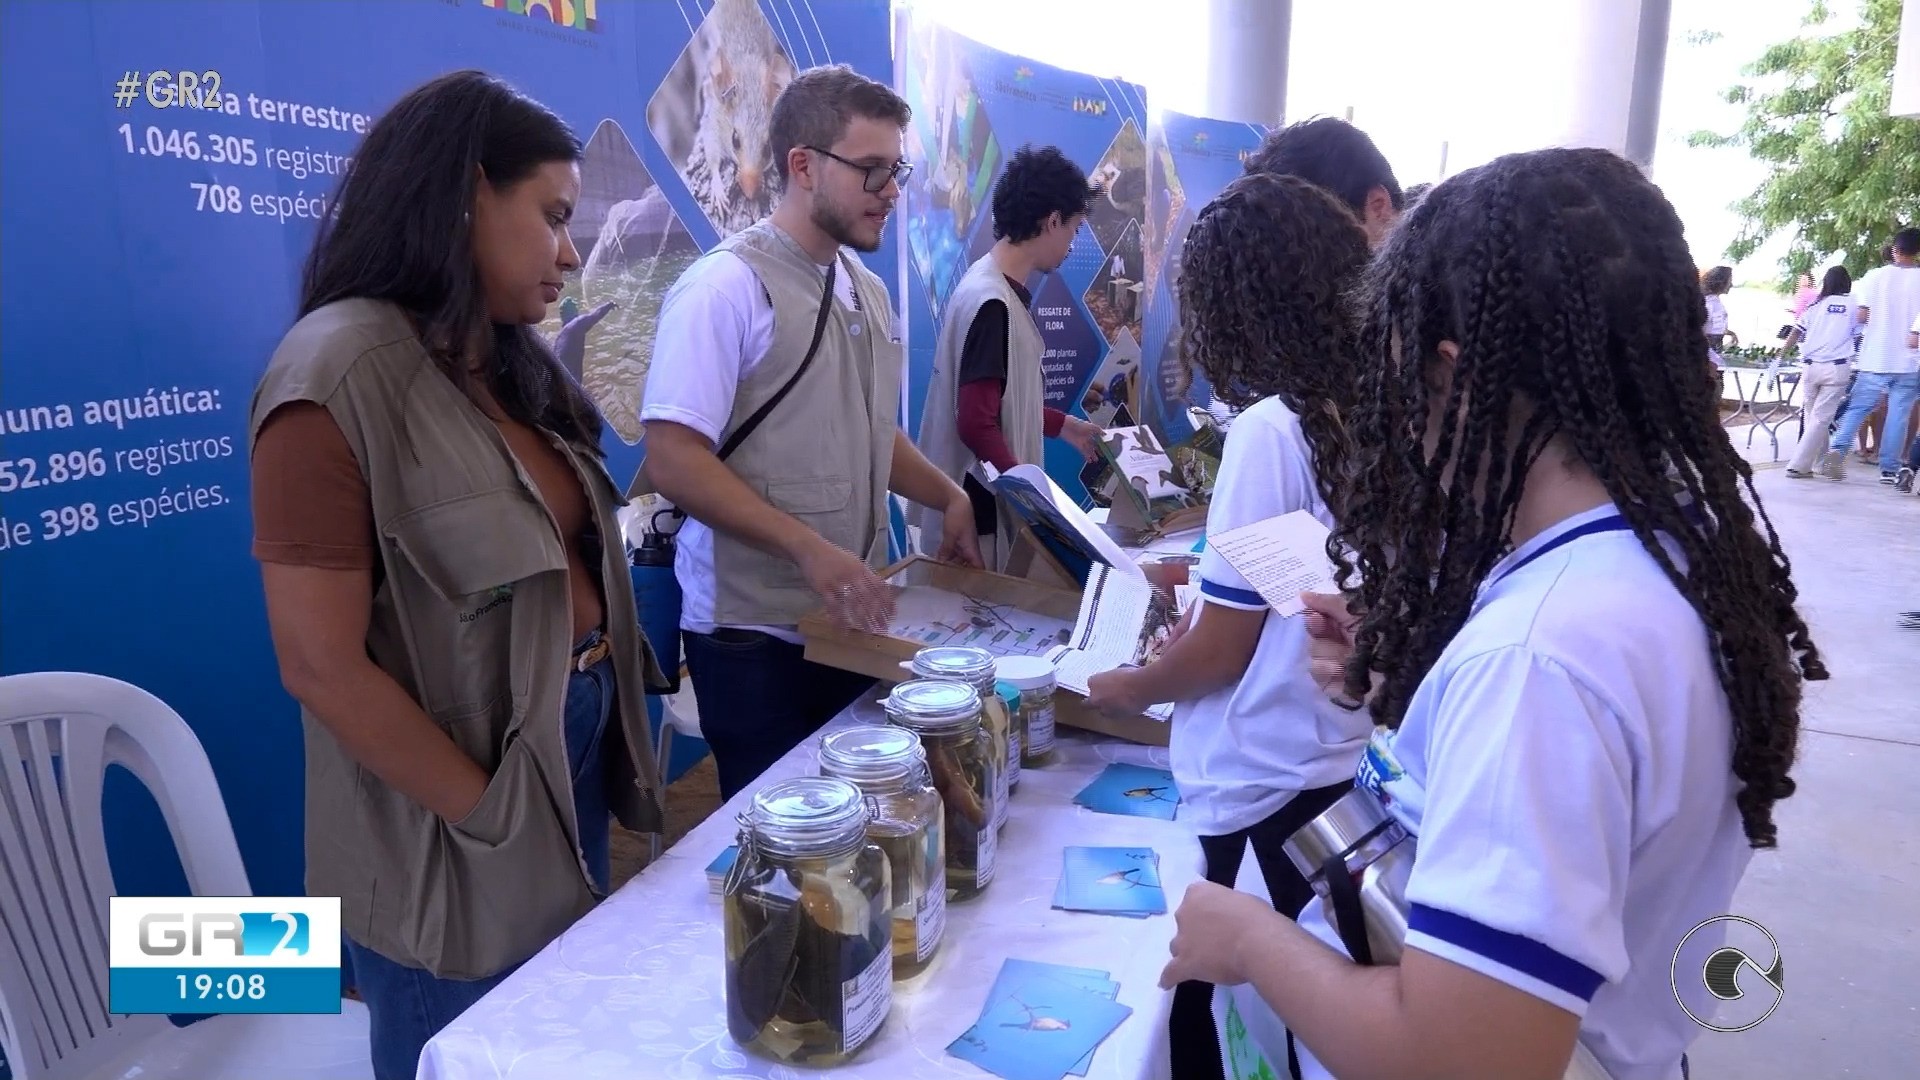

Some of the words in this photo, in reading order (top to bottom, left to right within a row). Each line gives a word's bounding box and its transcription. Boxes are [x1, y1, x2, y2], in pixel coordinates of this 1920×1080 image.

[248, 91, 371, 134] terrestre:
[118, 122, 258, 167] 1.046.305
[190, 183, 243, 213] 708
[1045, 321, 1065, 330] FLORA
[83, 386, 222, 431] aquática:
[115, 435, 234, 477] registros
[40, 502, 100, 542] 398
[108, 484, 230, 528] espécies.
